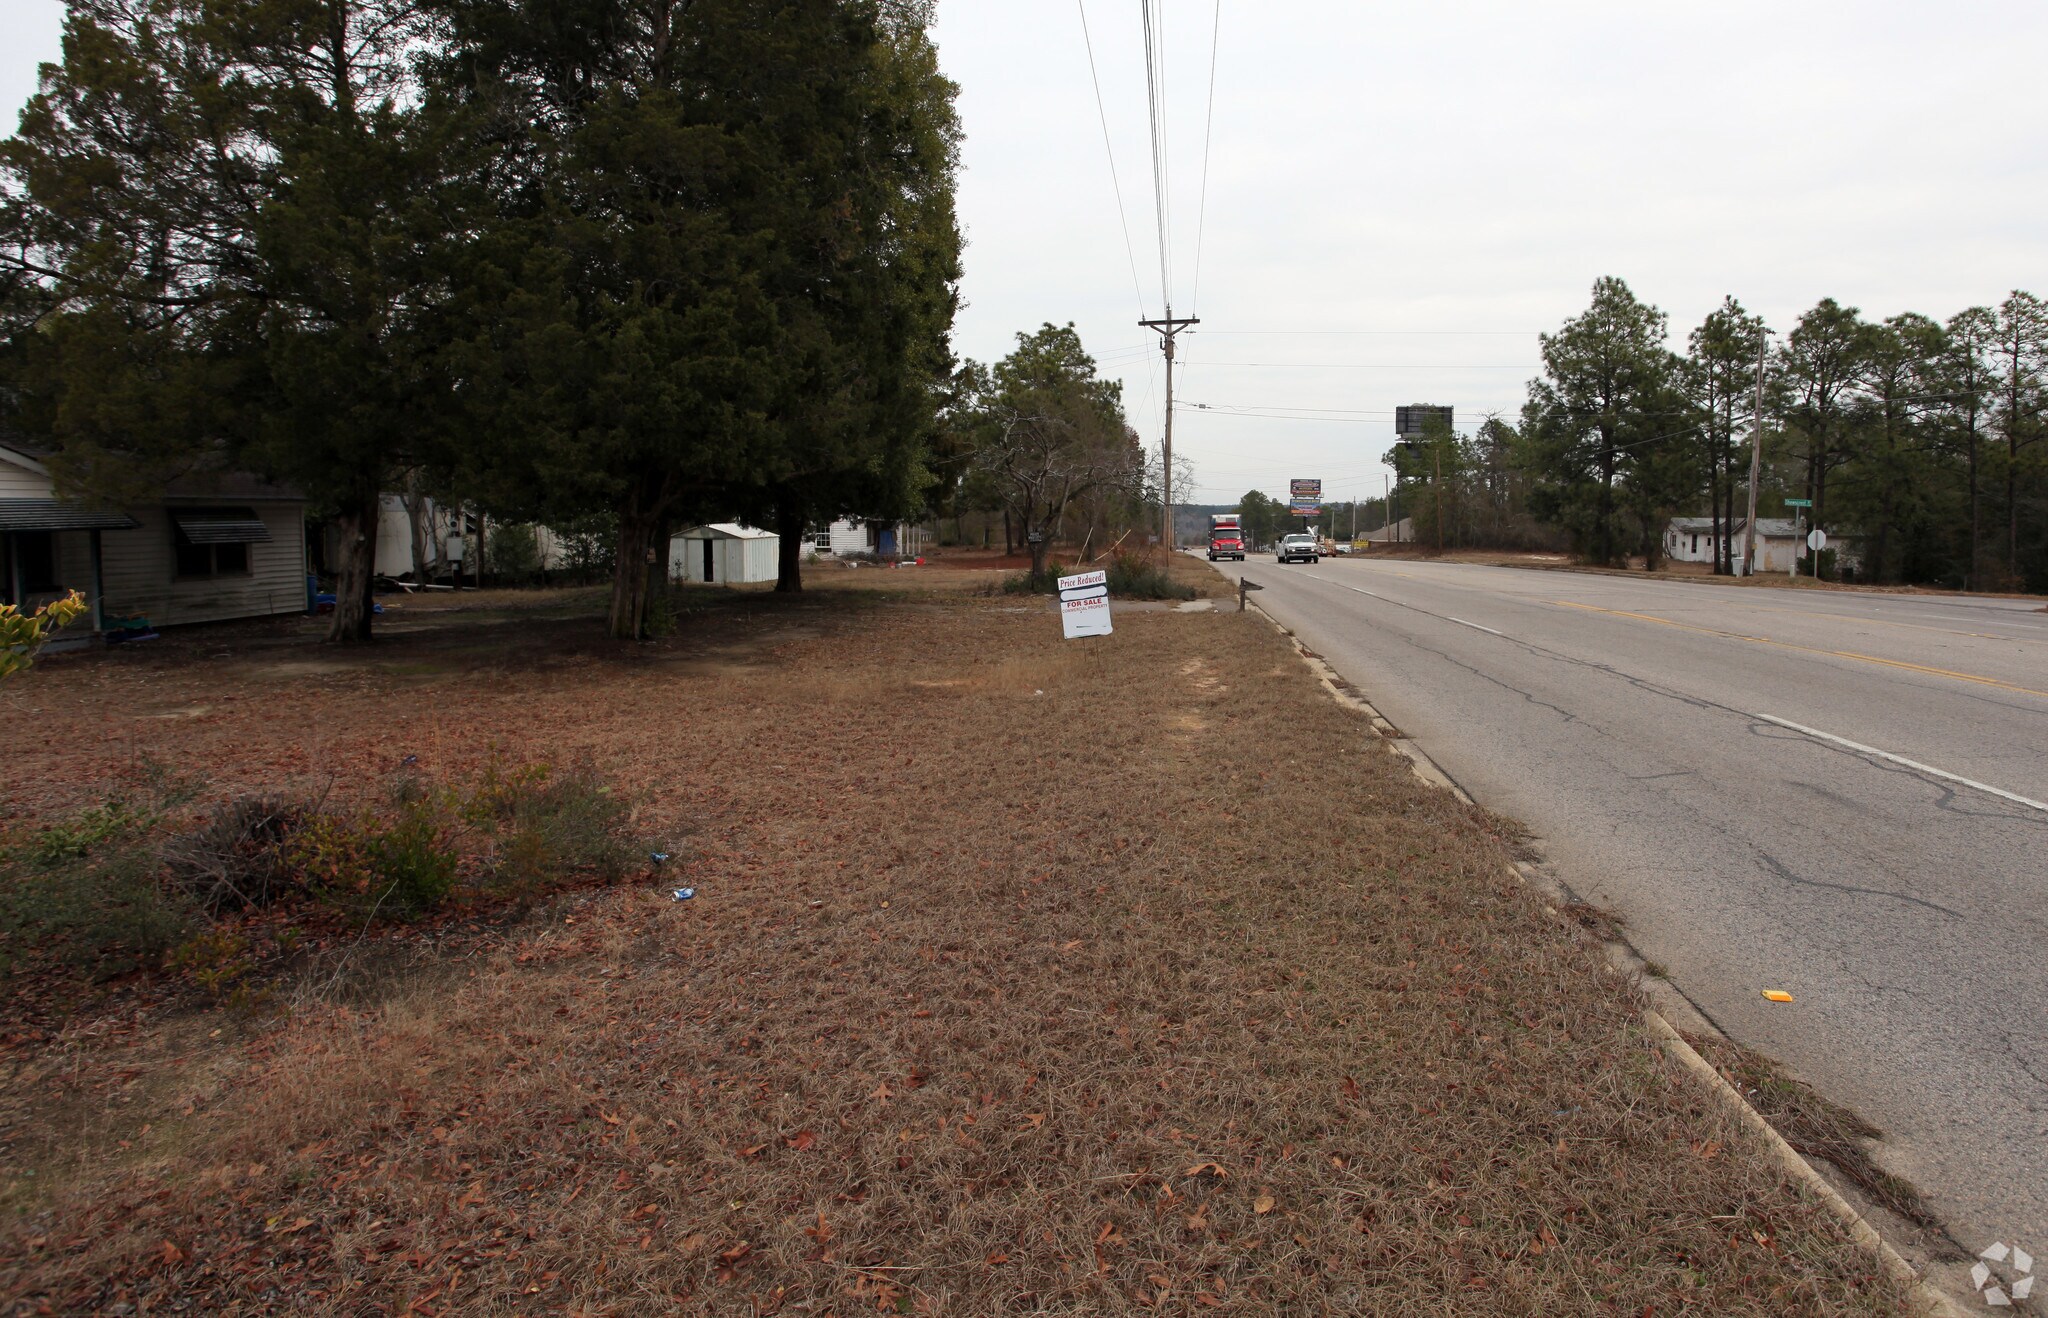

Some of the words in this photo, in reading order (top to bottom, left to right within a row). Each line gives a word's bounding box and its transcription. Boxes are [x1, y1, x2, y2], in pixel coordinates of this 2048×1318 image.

[1060, 578, 1075, 588] Price
[1077, 572, 1104, 585] Reduced!
[1083, 598, 1102, 606] SALE
